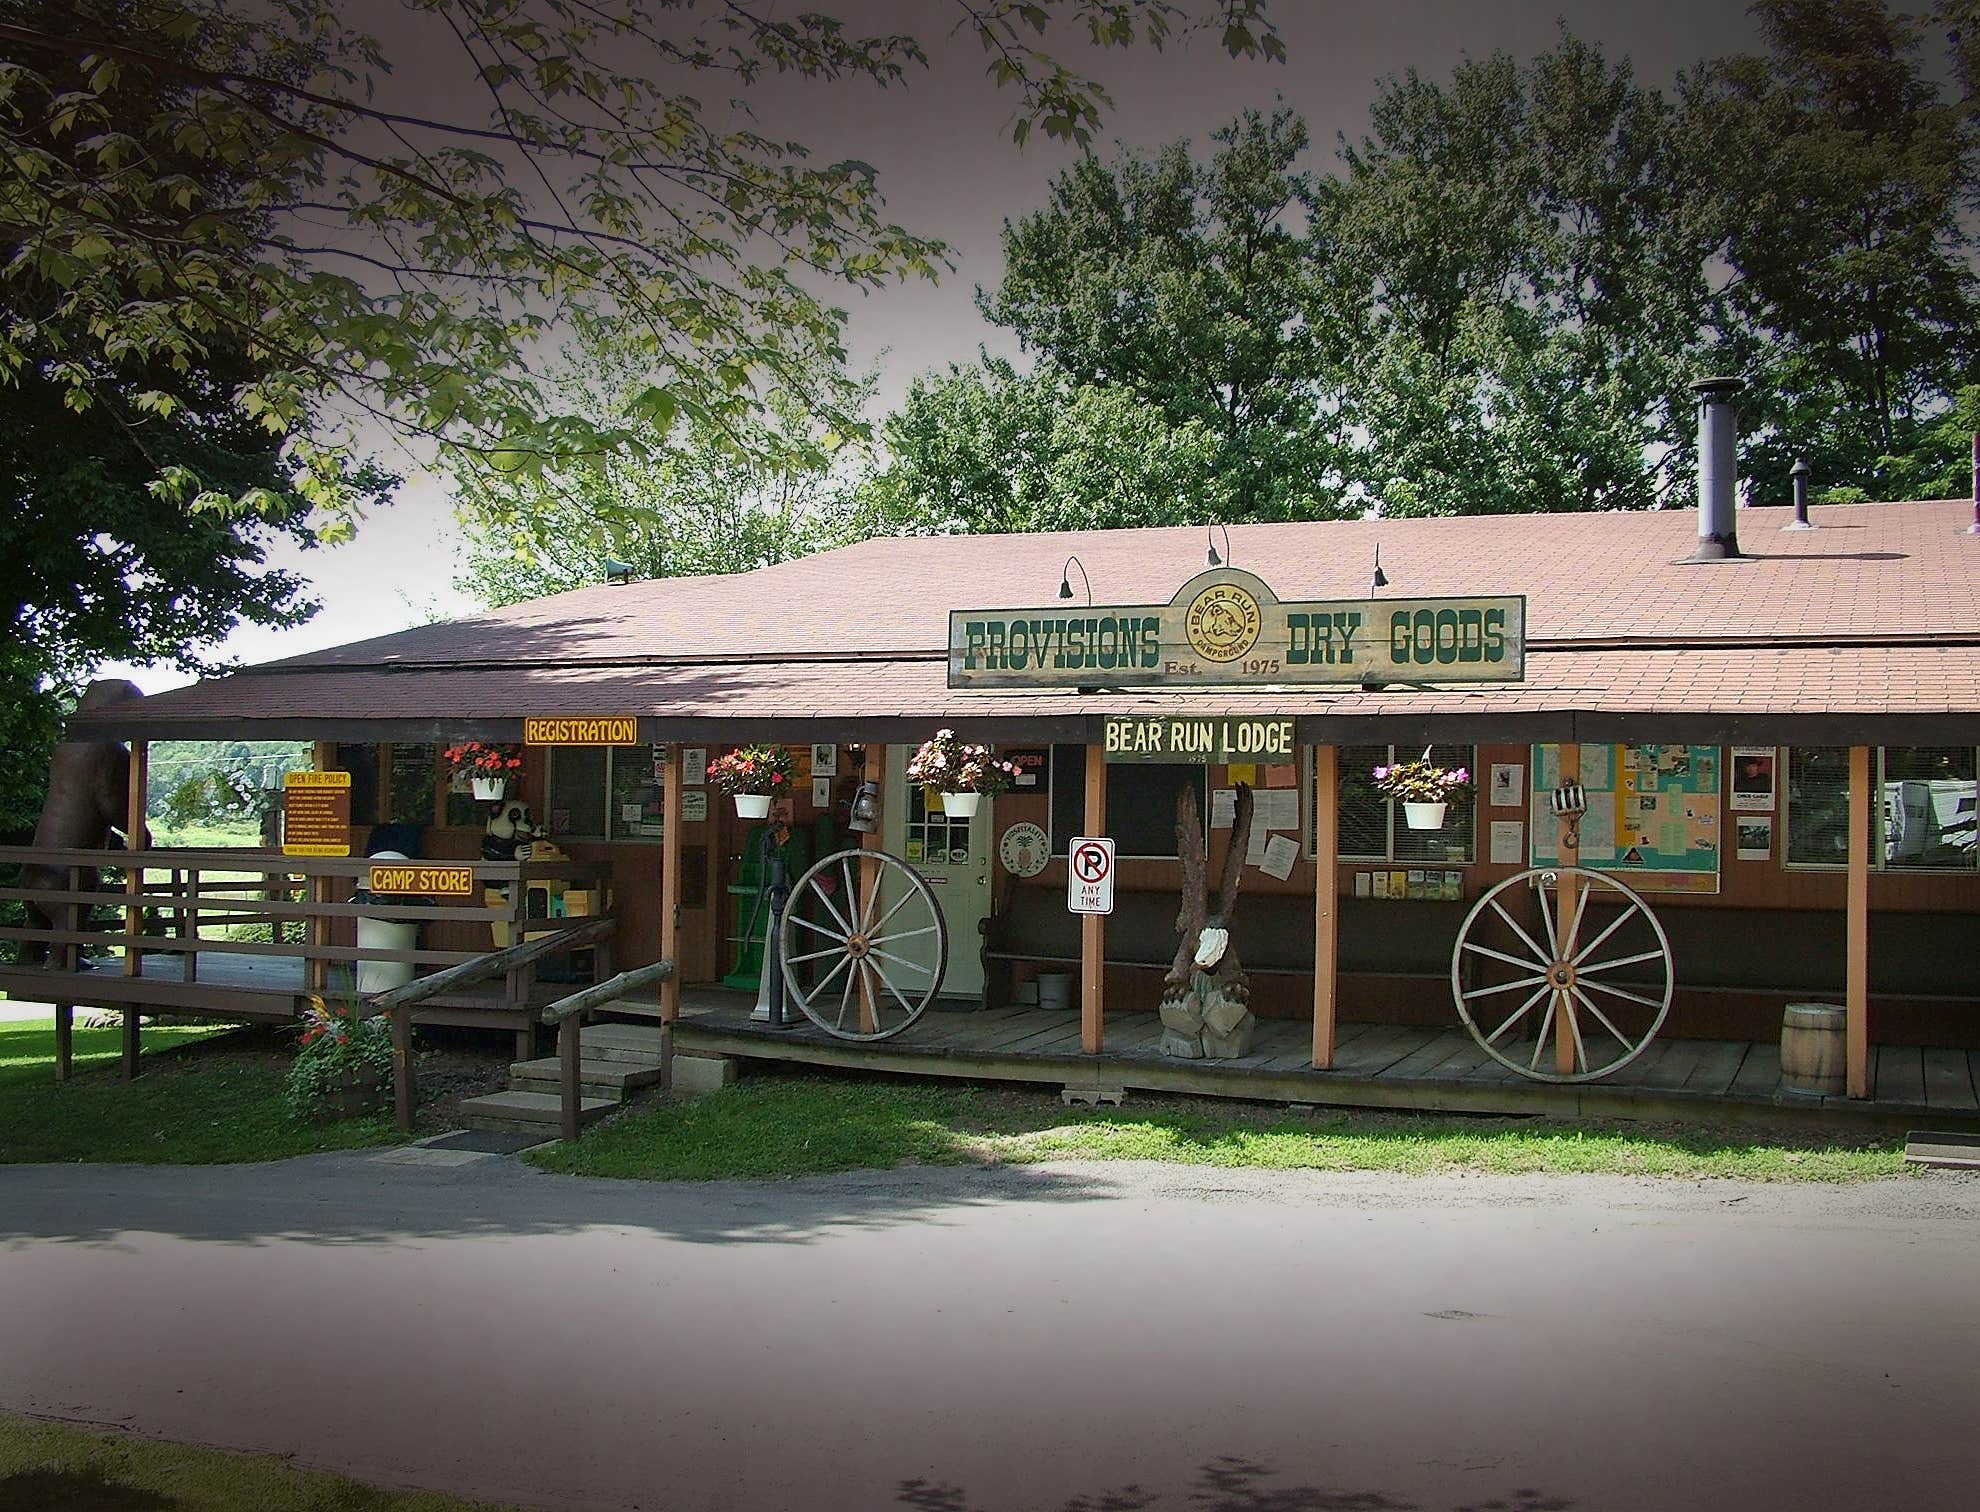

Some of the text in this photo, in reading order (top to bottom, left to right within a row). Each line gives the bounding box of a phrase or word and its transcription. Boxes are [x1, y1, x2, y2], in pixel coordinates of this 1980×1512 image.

[1191, 590, 1256, 625] BEAR RUN
[964, 608, 1505, 670] PROVISIONS DRY GOODS
[1197, 639, 1249, 658] CAMPGROUND
[1164, 659, 1280, 675] Est. 1975
[528, 720, 633, 741] REGISTRATION
[1105, 722, 1293, 754] BEAR RUN LODGE
[289, 774, 347, 784] OPEN FIRE POLICY
[373, 870, 469, 891] CAMP STORE
[1081, 885, 1100, 895] ANY
[1080, 896, 1101, 907] TIME
